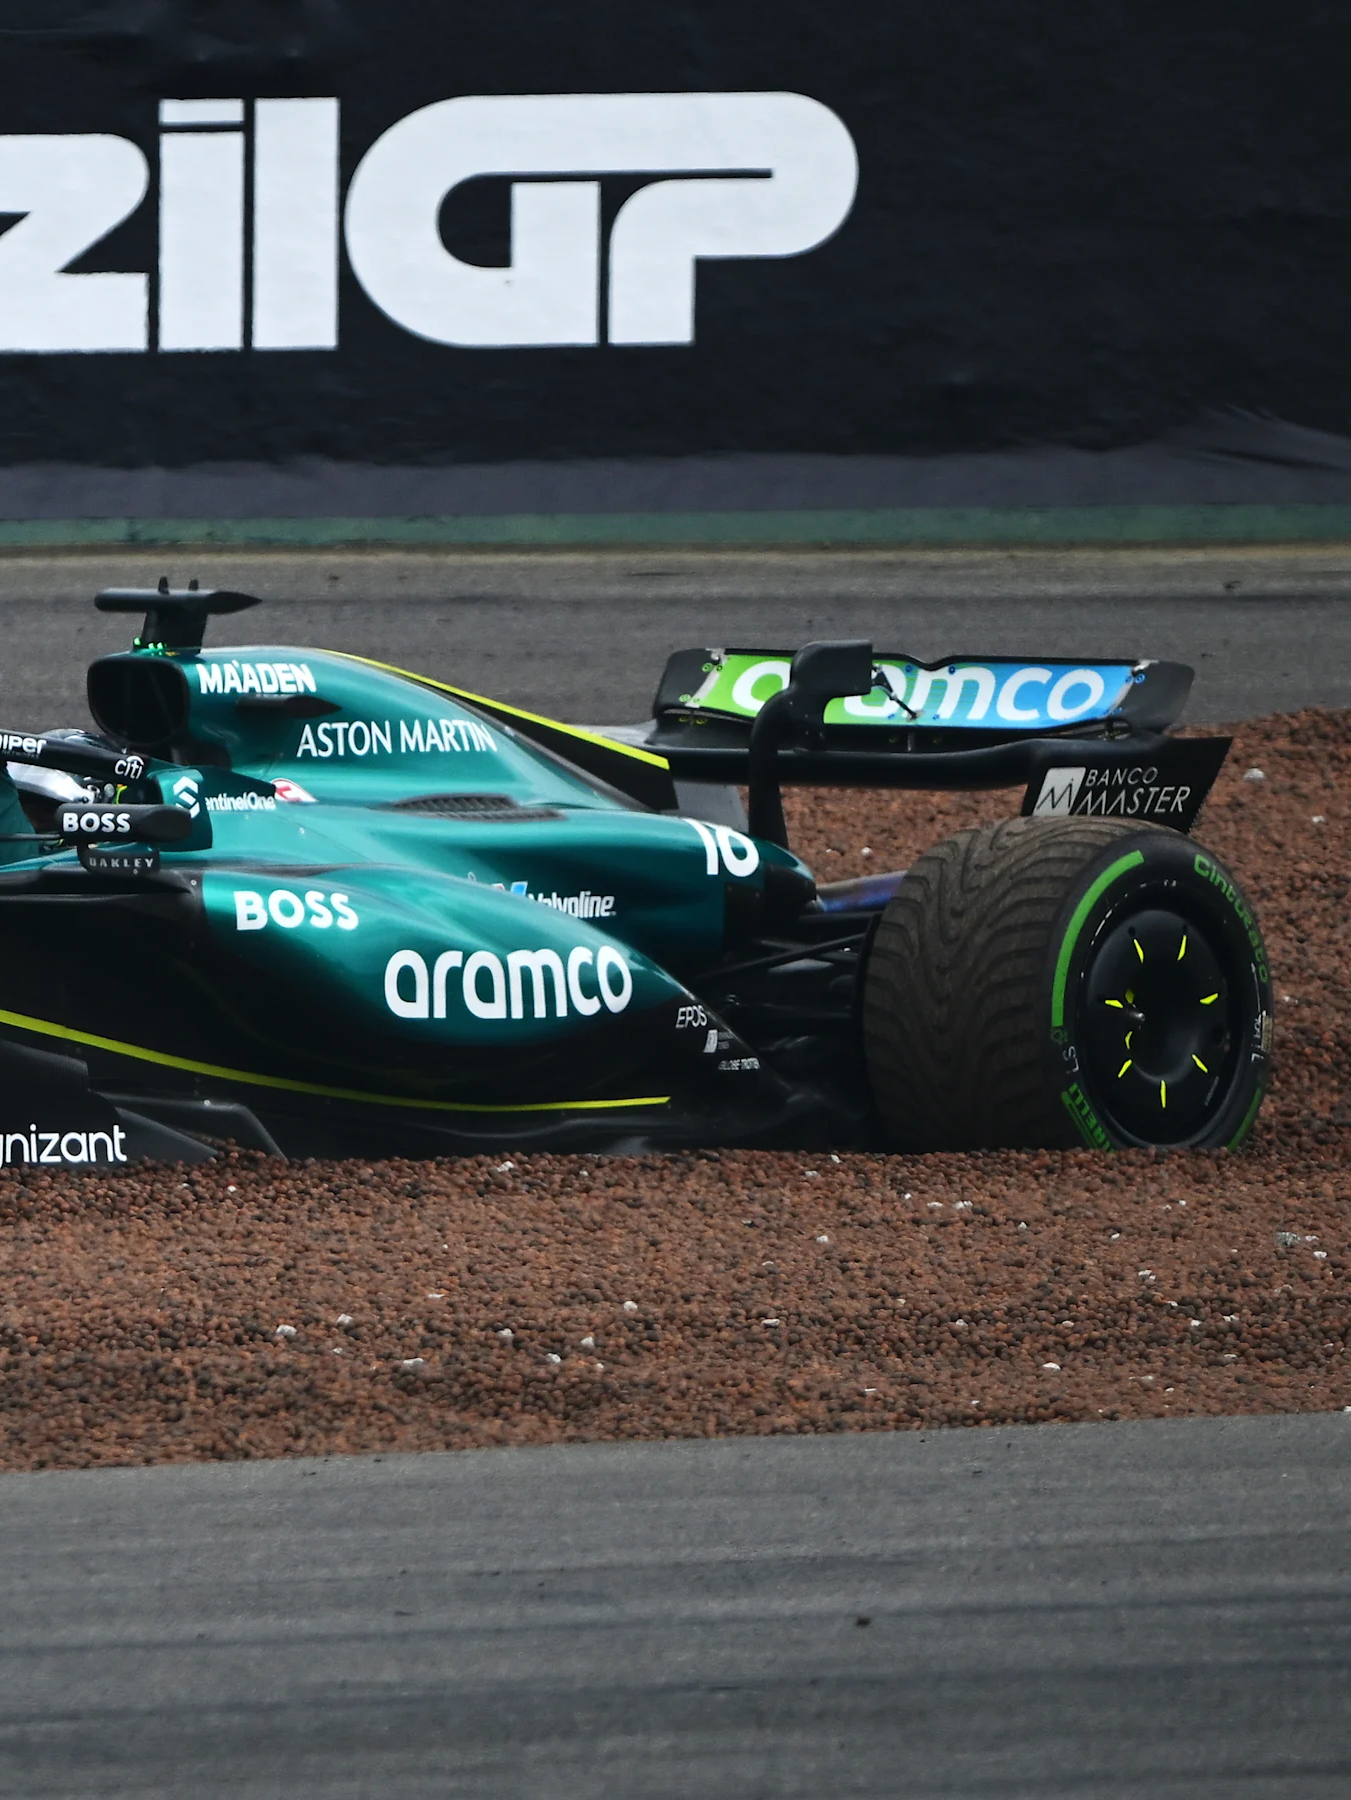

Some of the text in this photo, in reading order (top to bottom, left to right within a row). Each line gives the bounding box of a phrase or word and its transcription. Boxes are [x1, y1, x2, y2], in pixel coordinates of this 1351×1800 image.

[732, 661, 1104, 720] aamco
[296, 718, 498, 757] ASTON MARTIN
[115, 755, 144, 779] citi
[1085, 766, 1158, 787] BANCO
[1075, 786, 1190, 815] MASTER
[63, 812, 131, 833] BOSS
[89, 857, 154, 868] OAKLEY
[234, 890, 358, 930] BOSS
[1194, 855, 1268, 983] Cinturato
[385, 944, 632, 1019] aramco
[675, 1005, 707, 1029] EPOS
